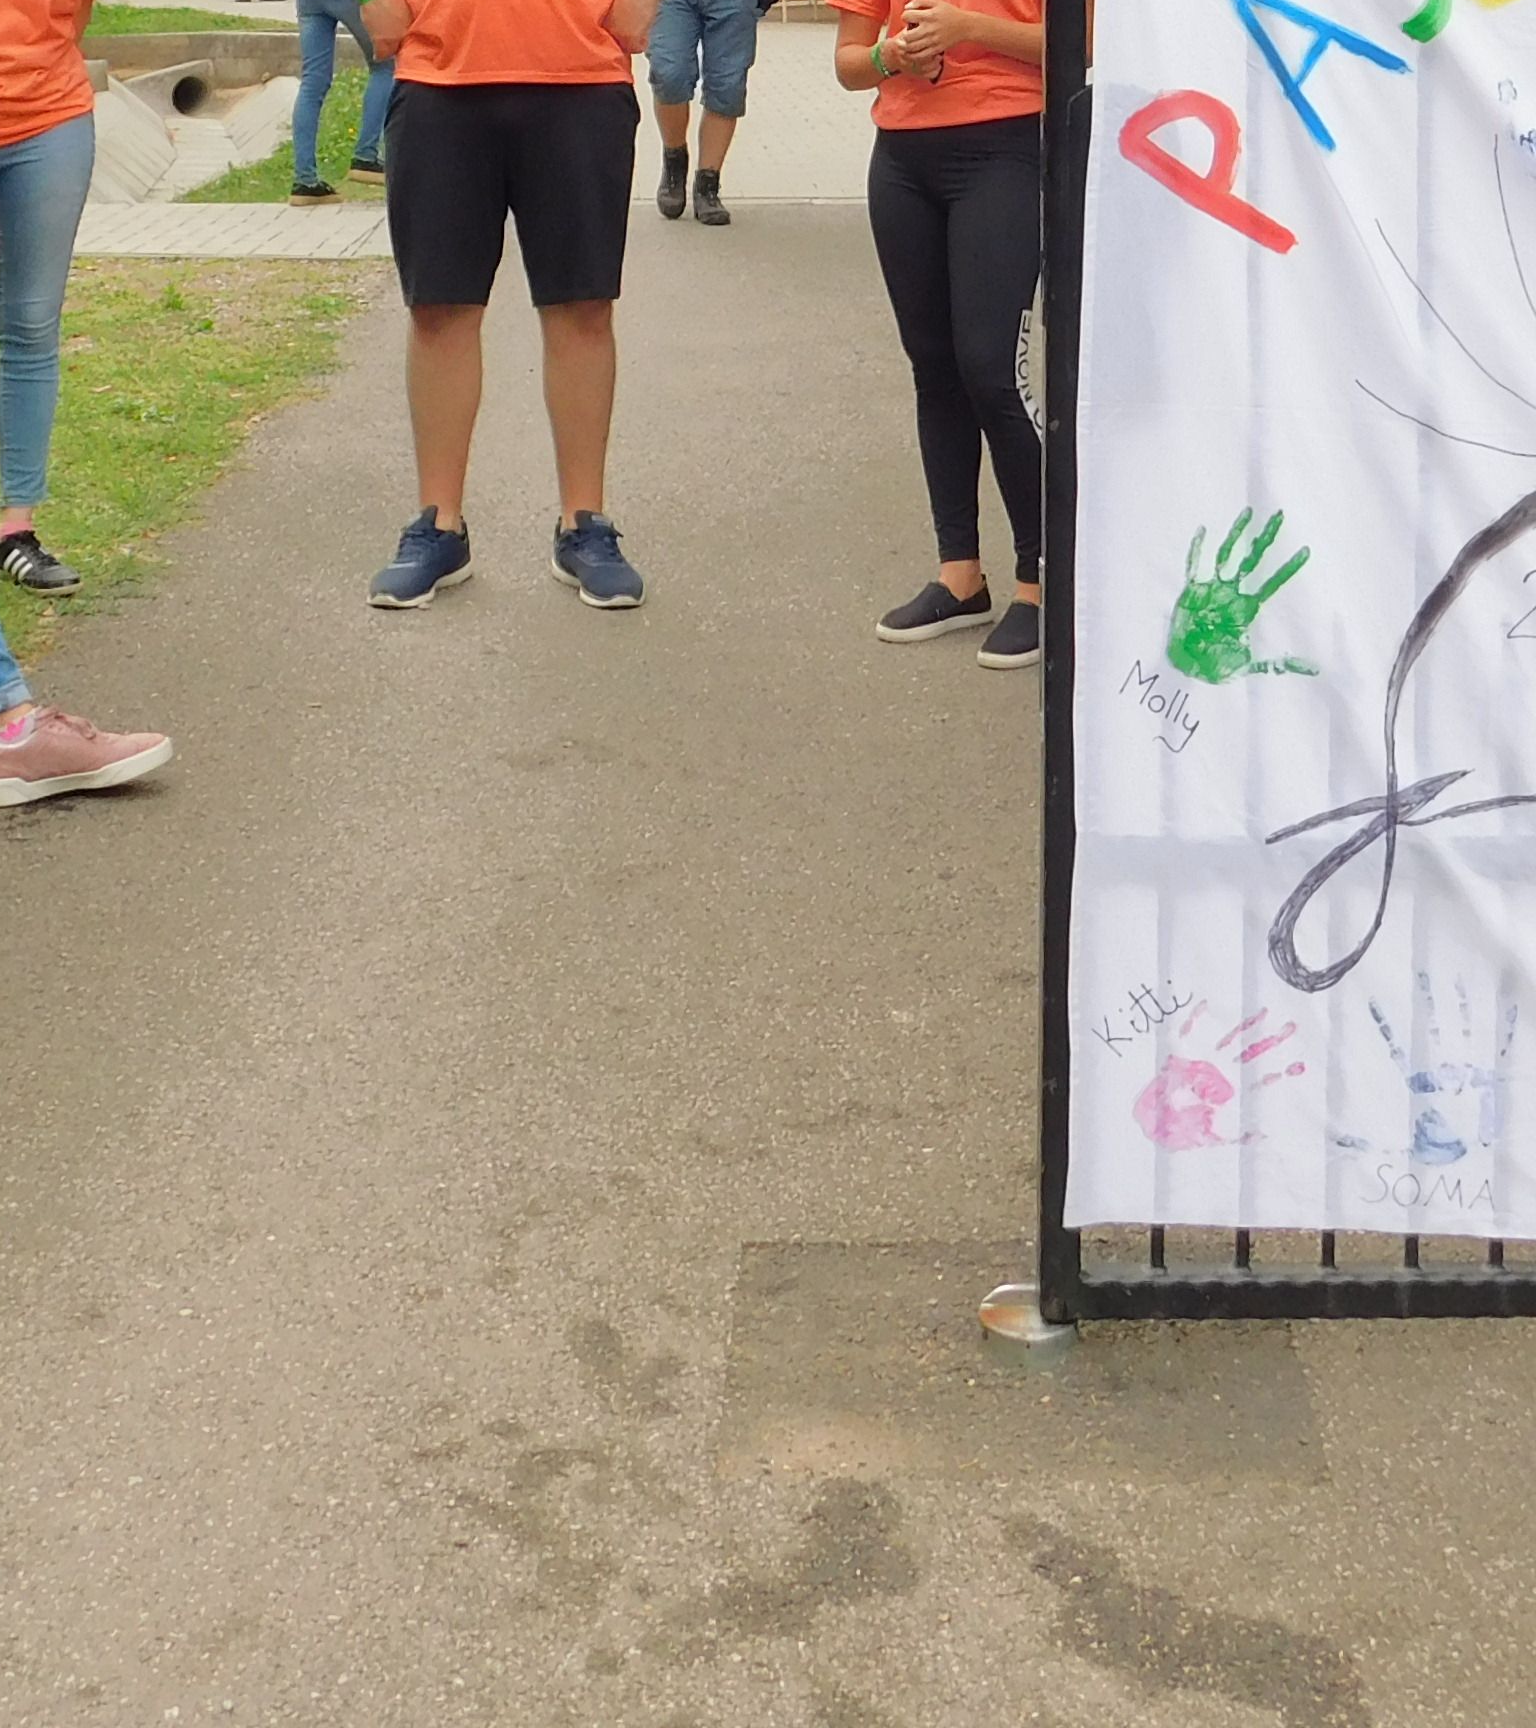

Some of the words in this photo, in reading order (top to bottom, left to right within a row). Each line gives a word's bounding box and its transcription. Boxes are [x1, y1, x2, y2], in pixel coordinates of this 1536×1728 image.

[1118, 658, 1200, 754] Molly
[1091, 979, 1193, 1058] Kitti
[1360, 1163, 1496, 1210] SOMA
